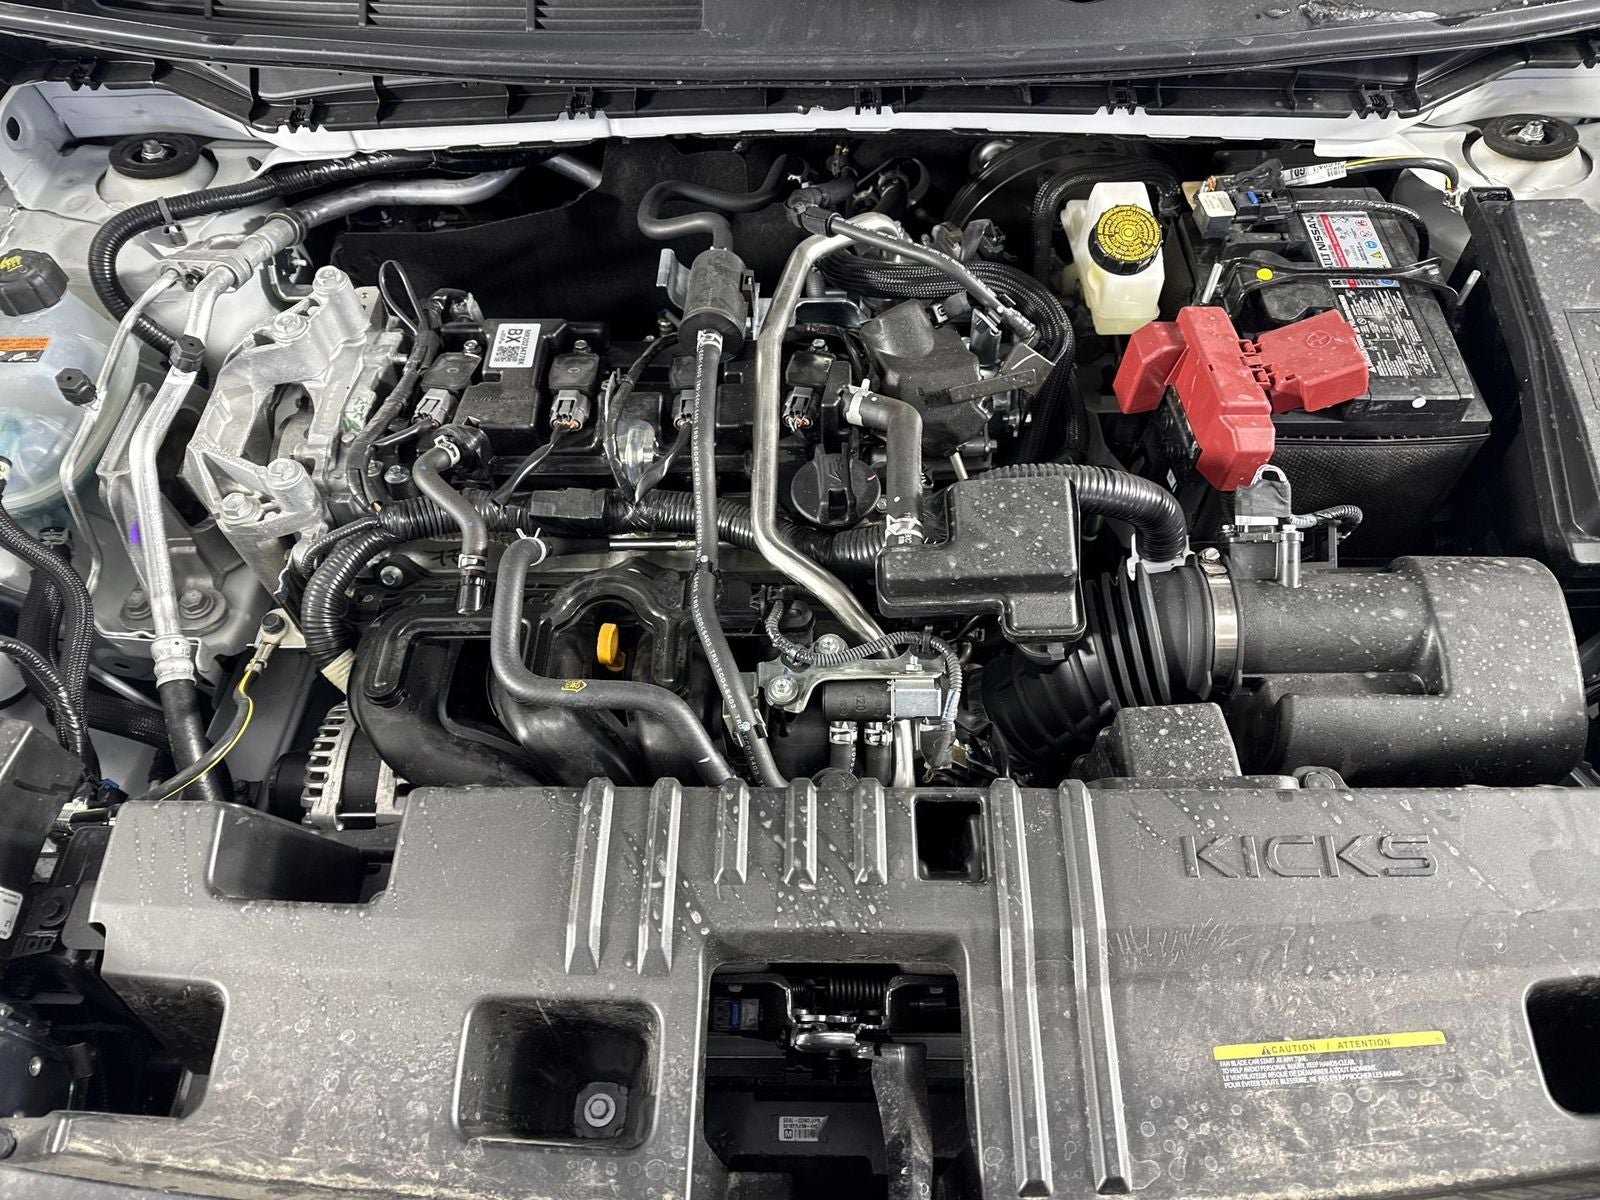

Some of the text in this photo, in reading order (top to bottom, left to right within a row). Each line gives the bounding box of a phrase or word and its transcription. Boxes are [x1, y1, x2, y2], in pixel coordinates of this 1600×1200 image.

[1306, 216, 1328, 251] NISSAN
[505, 328, 524, 343] BX
[1181, 833, 1439, 878] KICKS
[1271, 1043, 1316, 1054] CAUTION
[1337, 1038, 1391, 1049] ATTENTION
[1230, 1066, 1243, 1074] HELP
[1244, 1065, 1260, 1073] AVOID
[1260, 1064, 1286, 1072] PERSONAL
[1231, 1059, 1248, 1067] BLADE
[1230, 1072, 1267, 1081] VENTILATEUR
[1267, 1071, 1288, 1079] RISQUE
